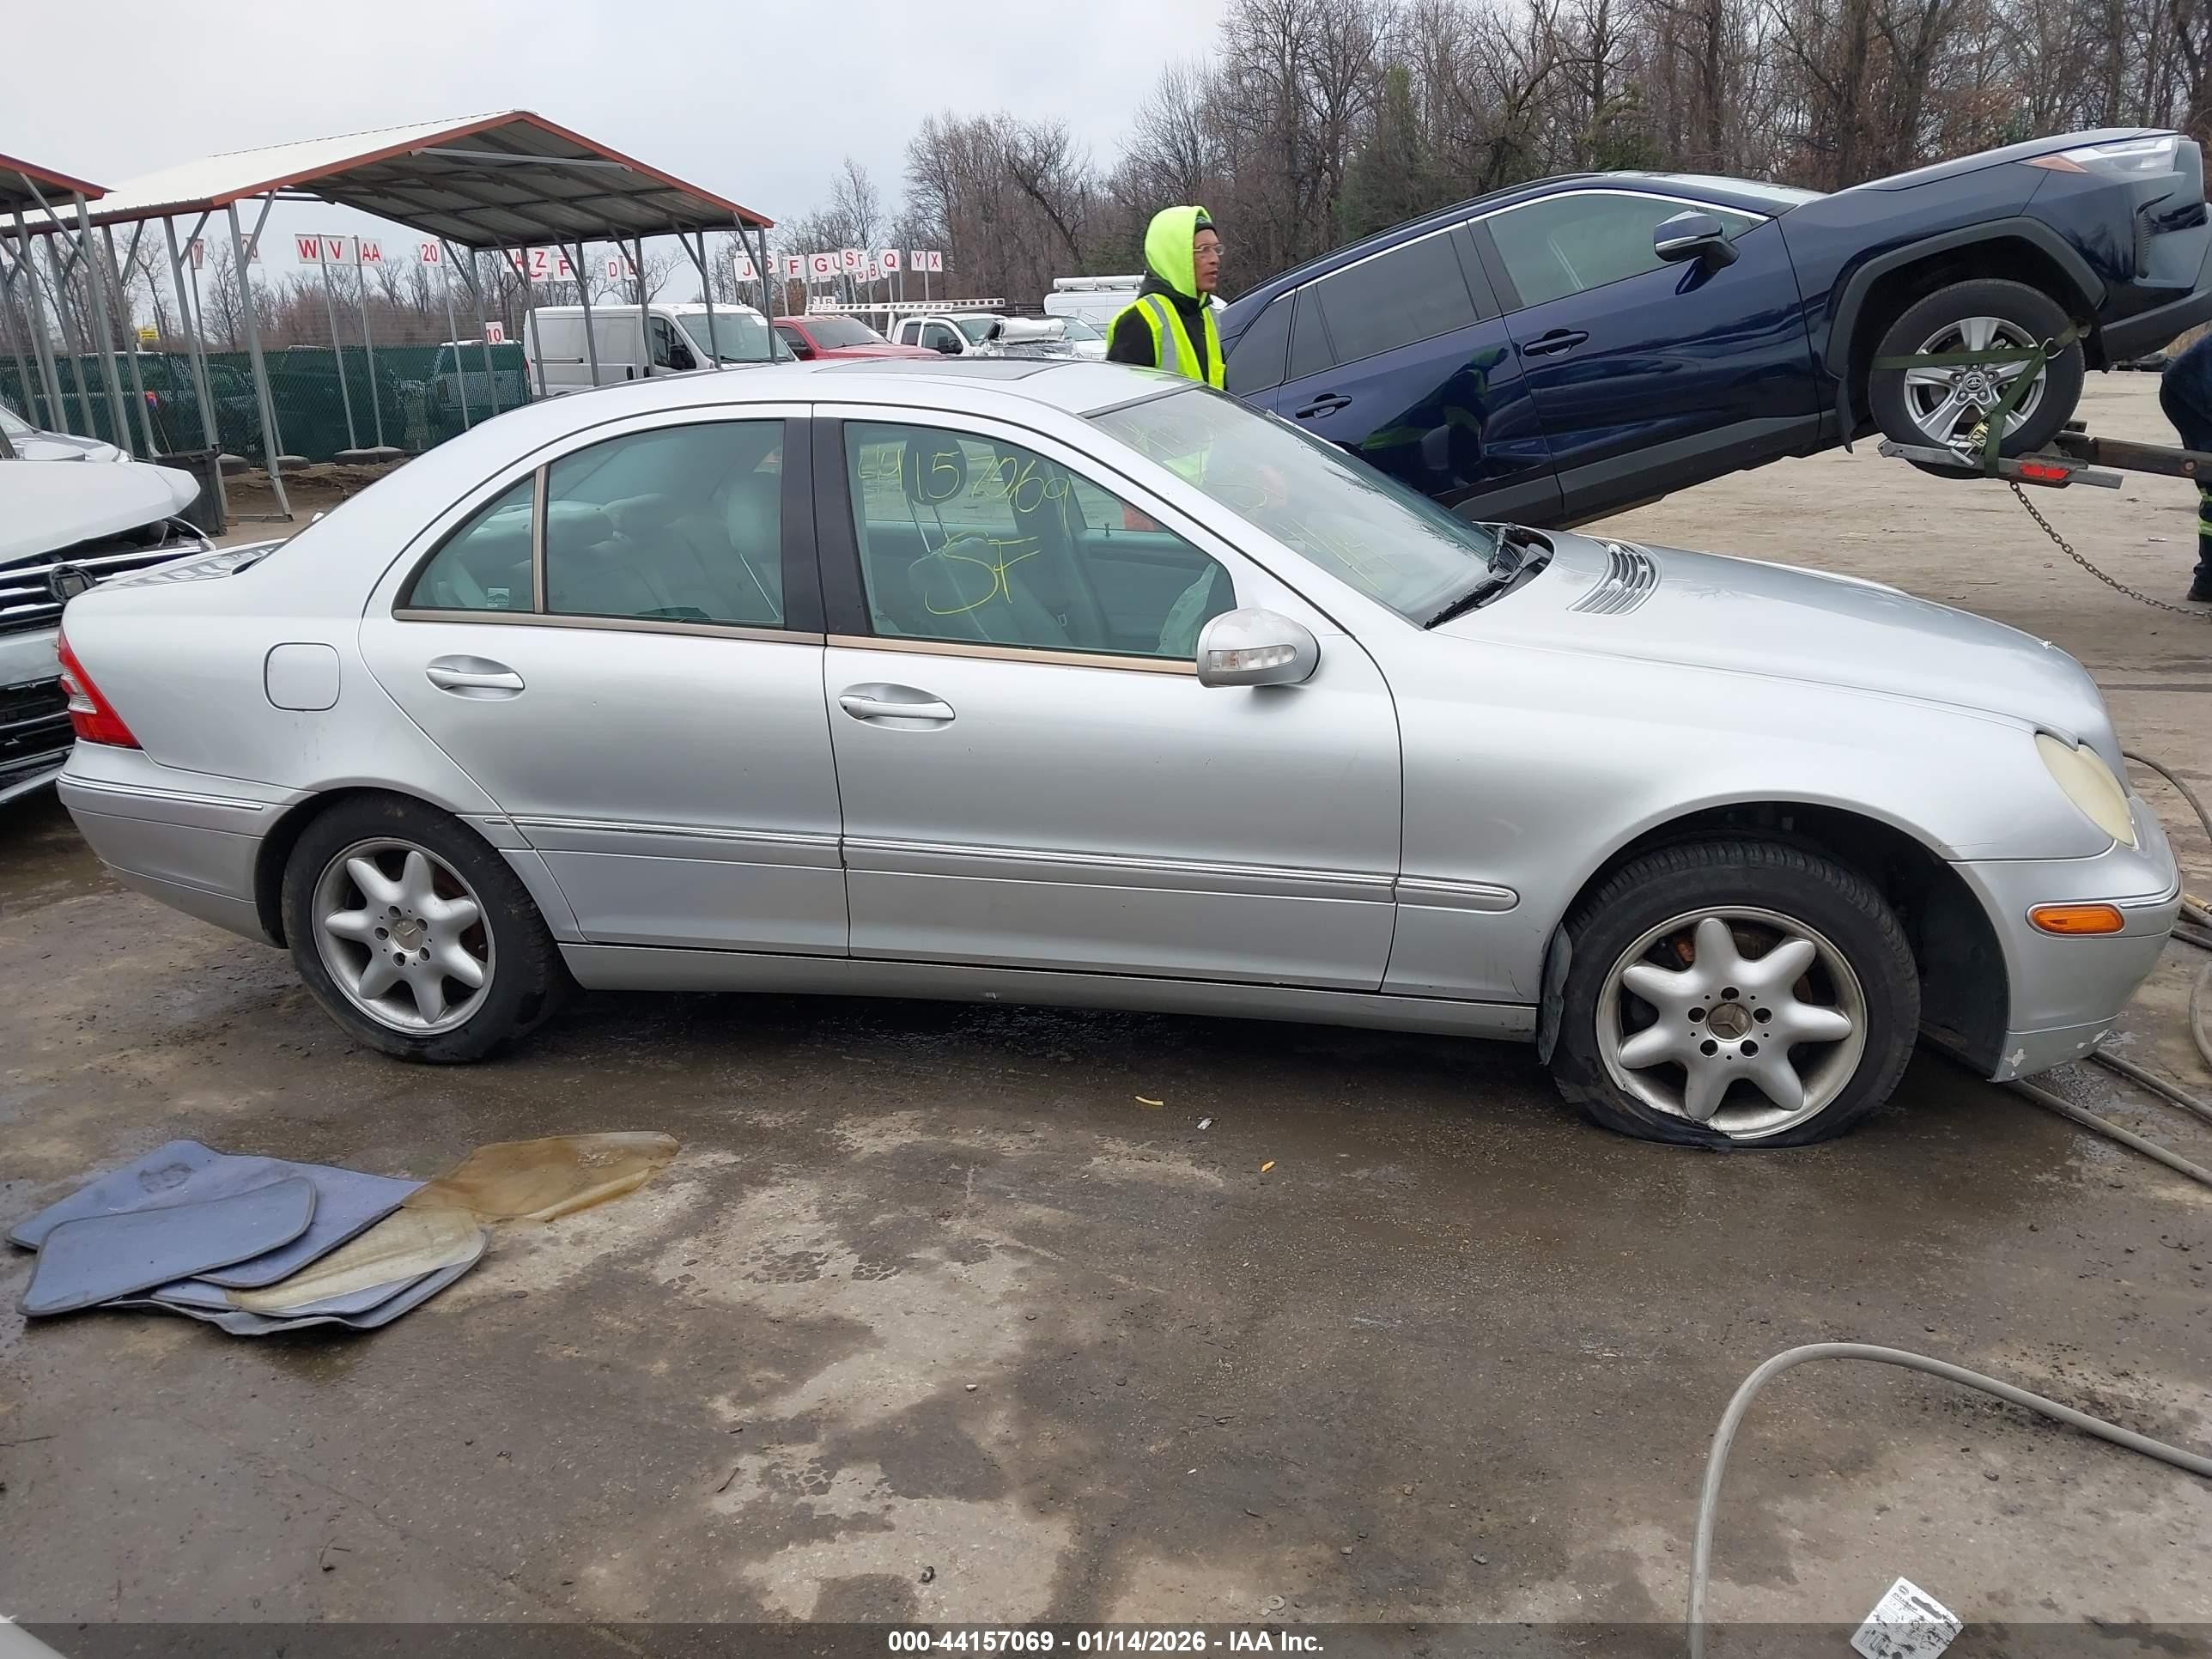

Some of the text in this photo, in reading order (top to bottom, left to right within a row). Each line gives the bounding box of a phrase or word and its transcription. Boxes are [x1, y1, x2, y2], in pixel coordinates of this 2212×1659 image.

[297, 240, 317, 259] W
[329, 240, 342, 259] V
[362, 242, 381, 262] AA
[422, 244, 438, 262] 20
[534, 251, 547, 269] Z
[814, 258, 828, 272] G
[845, 251, 854, 266] S
[884, 252, 896, 268] Q
[914, 252, 922, 267] Y
[931, 253, 939, 268] X
[558, 259, 570, 276] F
[608, 261, 618, 277] D
[742, 261, 751, 276] J
[789, 259, 799, 275] F
[486, 328, 501, 343] 10
